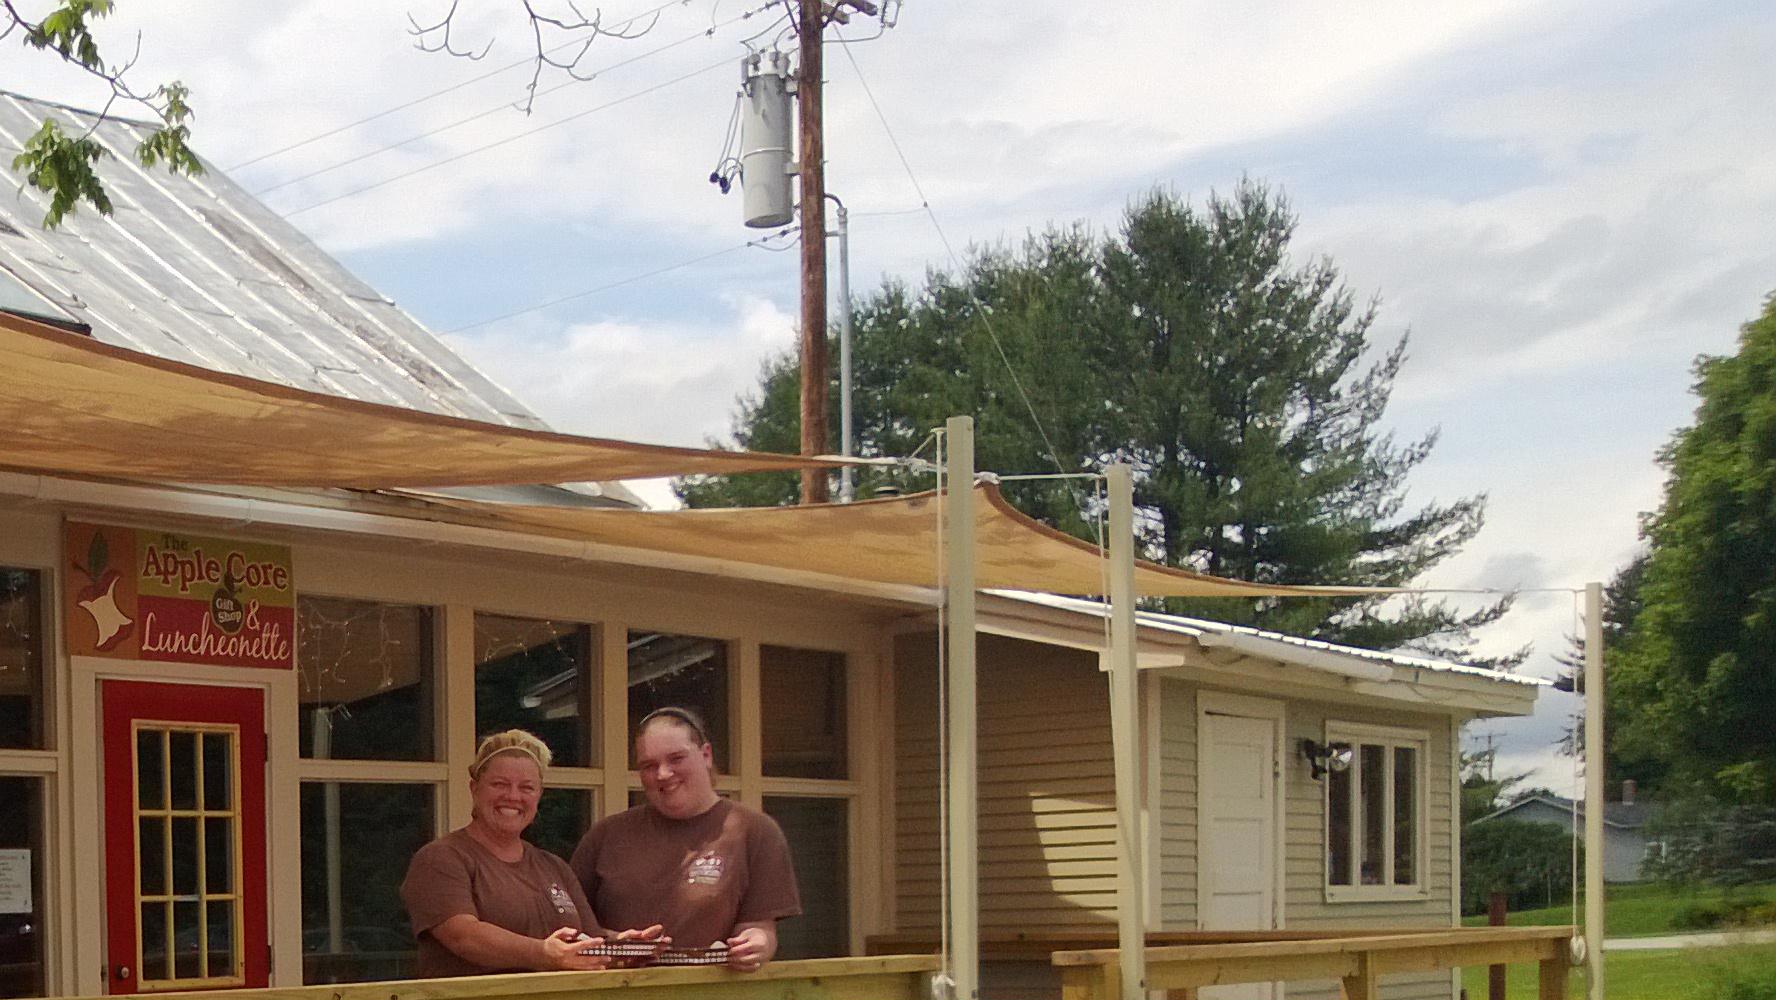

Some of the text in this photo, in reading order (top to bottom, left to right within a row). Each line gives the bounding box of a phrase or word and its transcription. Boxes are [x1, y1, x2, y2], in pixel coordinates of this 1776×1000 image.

[162, 533, 189, 551] The
[142, 545, 288, 593] Apple Core
[218, 610, 242, 623] Shop
[246, 599, 260, 630] &
[142, 612, 289, 661] Luncheonette
